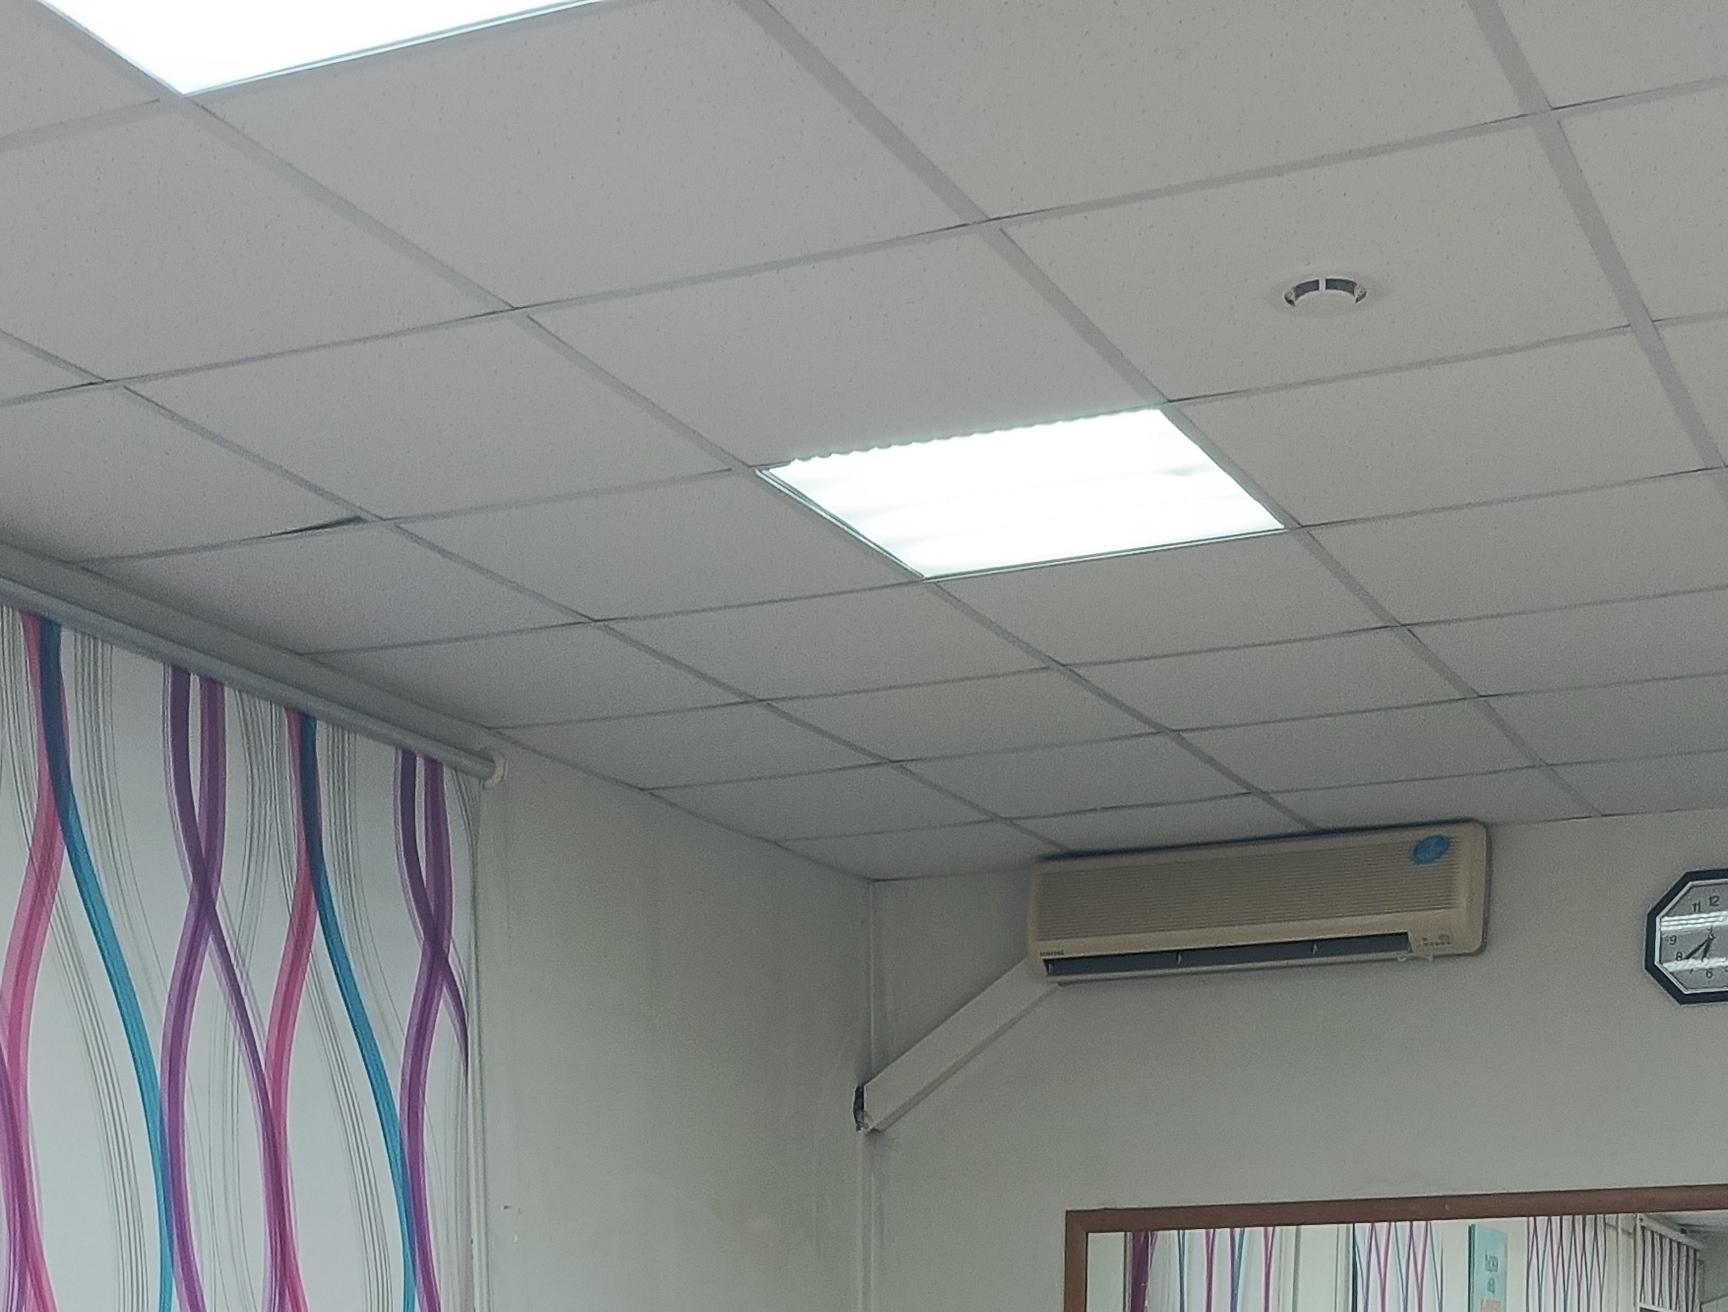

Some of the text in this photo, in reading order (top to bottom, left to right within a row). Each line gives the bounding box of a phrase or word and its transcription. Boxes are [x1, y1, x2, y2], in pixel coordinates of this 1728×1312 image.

[1708, 895, 1720, 907] 12
[1669, 935, 1677, 945] 9
[1675, 951, 1683, 961] 8
[1705, 969, 1713, 979] 6
